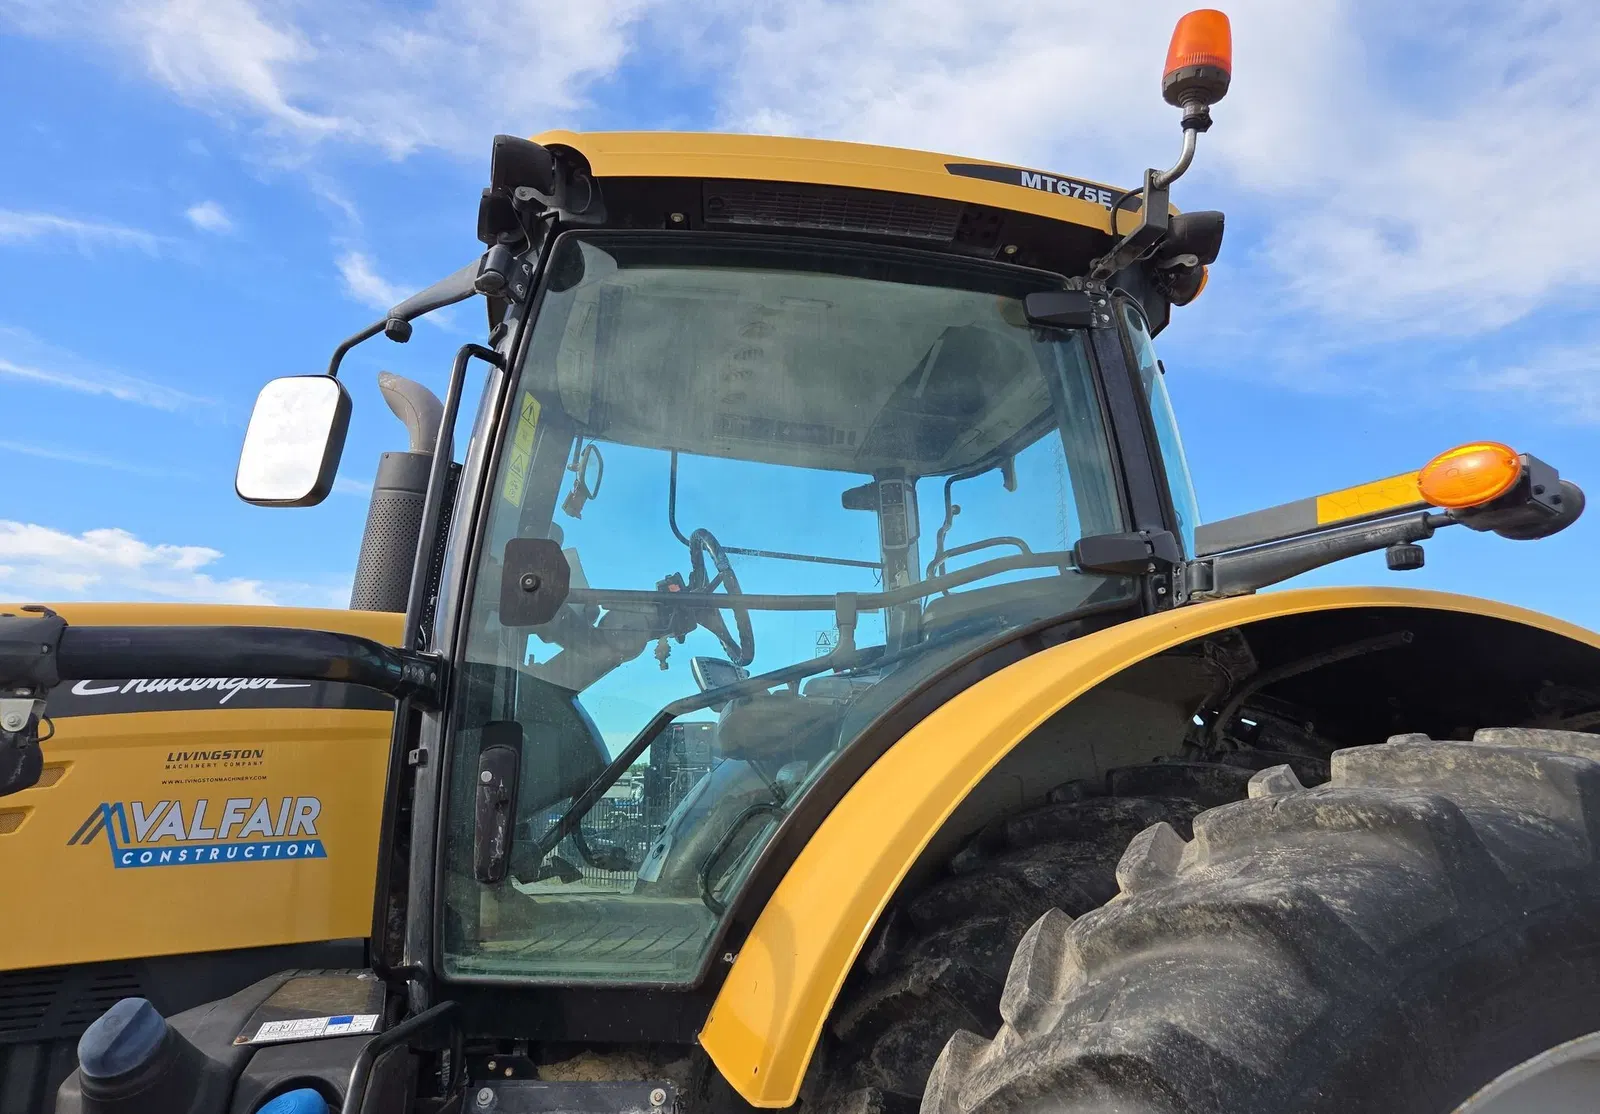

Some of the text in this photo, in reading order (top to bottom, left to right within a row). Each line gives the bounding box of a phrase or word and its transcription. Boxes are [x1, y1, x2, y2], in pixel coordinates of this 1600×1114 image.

[1021, 171, 1112, 207] MT675E
[166, 749, 264, 762] LIVINGSTON
[130, 796, 322, 843] VALFAIR
[122, 843, 316, 865] CONSTRUCTION
